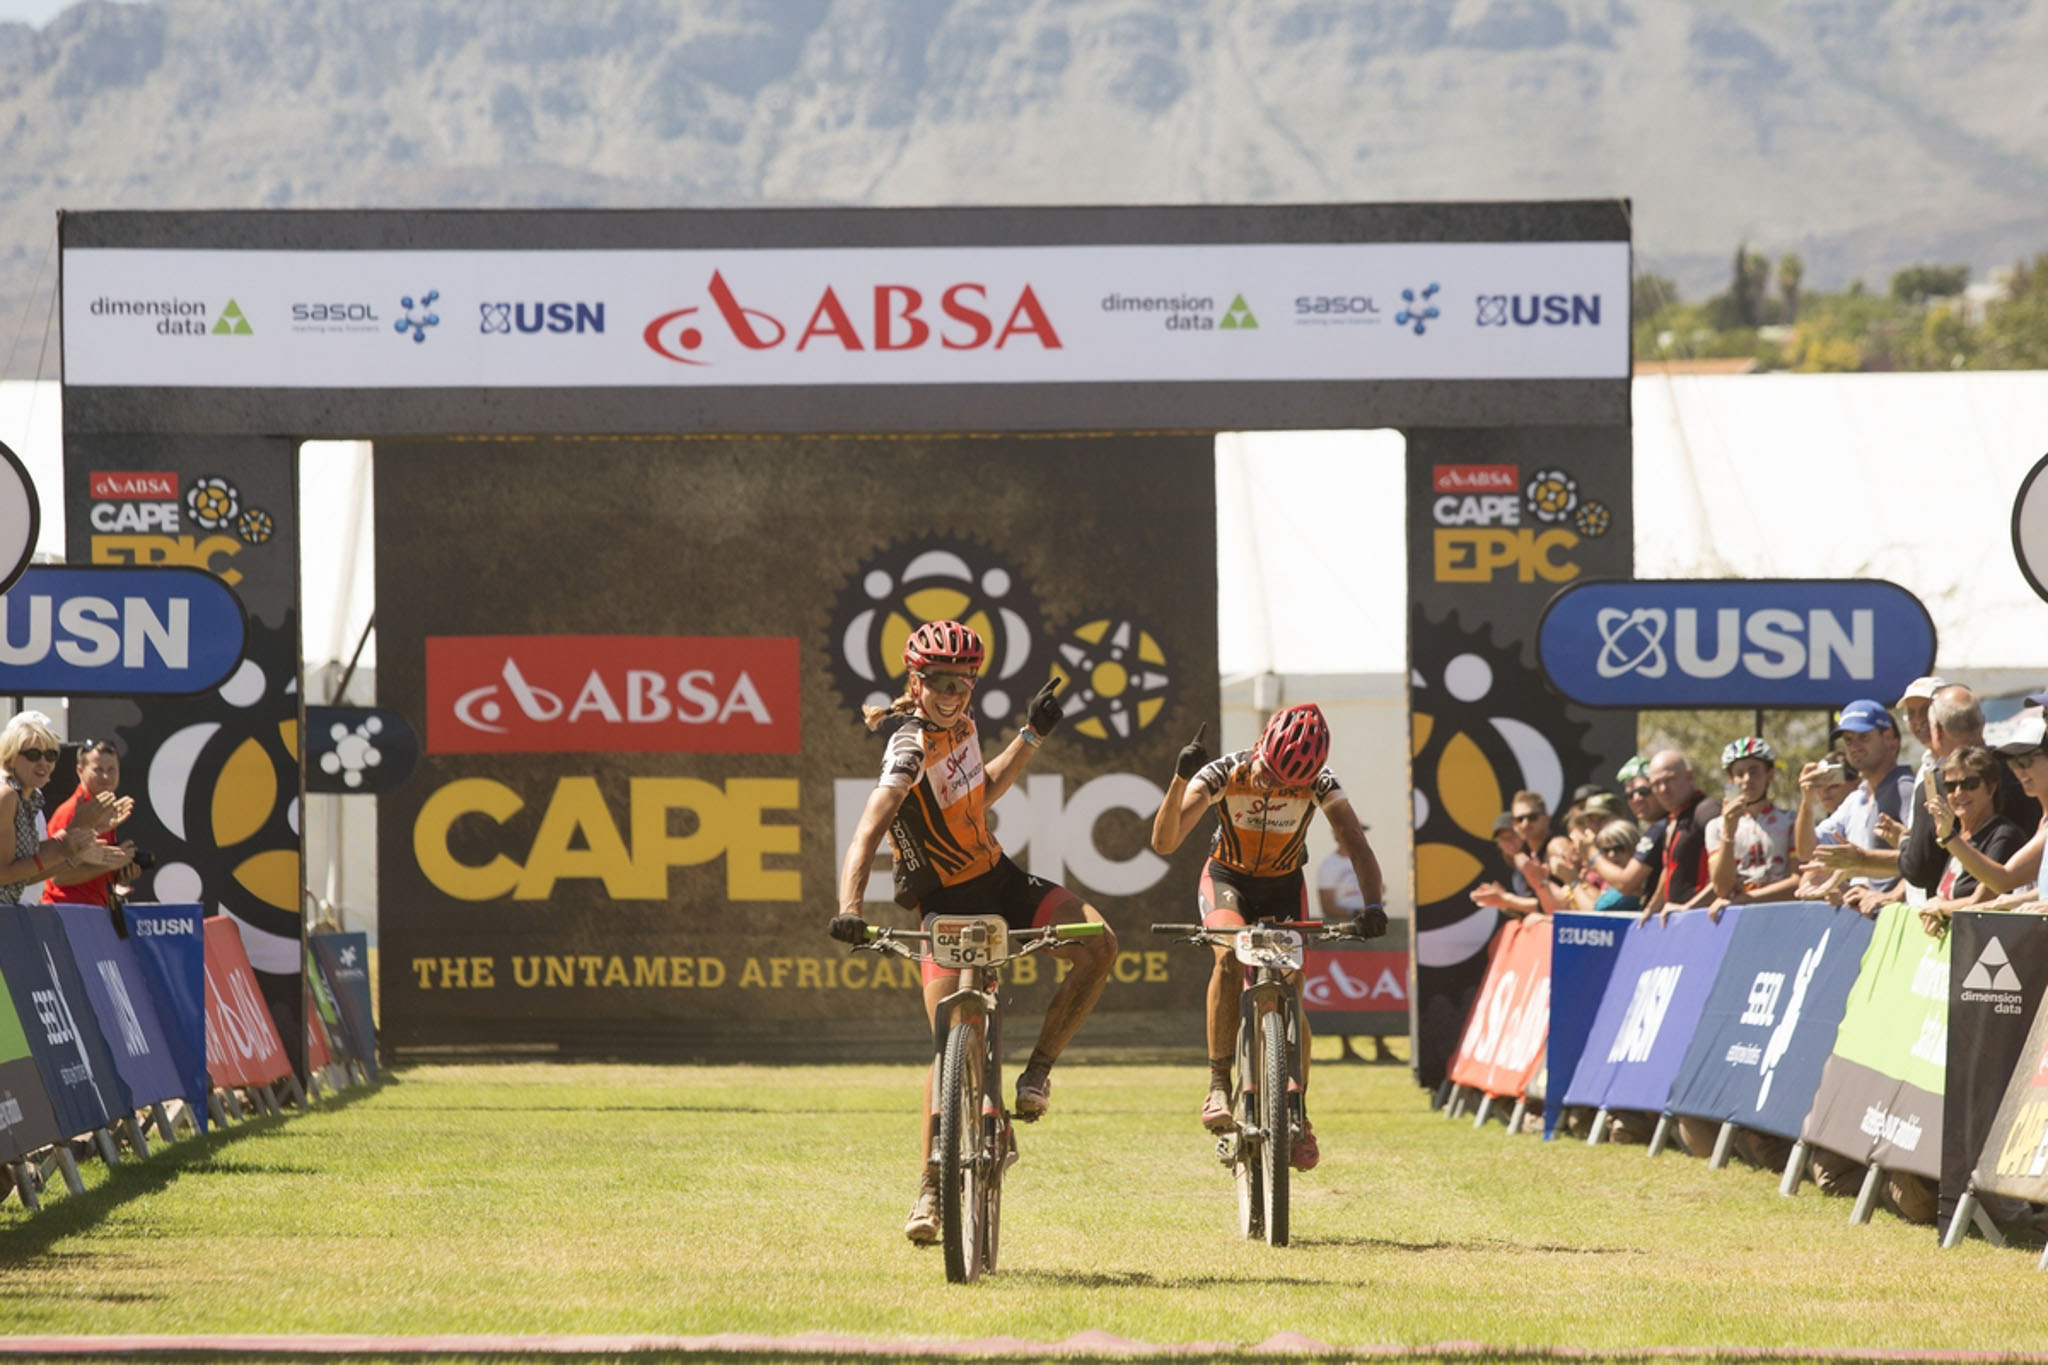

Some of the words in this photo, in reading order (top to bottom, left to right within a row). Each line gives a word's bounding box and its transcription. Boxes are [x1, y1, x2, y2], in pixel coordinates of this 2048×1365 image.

[90, 297, 206, 316] dimension
[795, 283, 1063, 351] ABSA
[1101, 293, 1213, 311] dimension
[1511, 294, 1601, 326] USN
[156, 317, 206, 335] data
[513, 301, 605, 334] USN
[1165, 312, 1213, 331] data
[124, 478, 172, 494] ABSA
[90, 502, 180, 532] CAPE
[1433, 495, 1521, 526] CAPE
[1433, 528, 1582, 584] EPIC
[0, 595, 190, 670] USN
[1674, 608, 1875, 681] USN
[567, 668, 773, 724] ABSA
[412, 776, 802, 901] CAPE
[152, 917, 194, 936] USN
[1574, 927, 1614, 947] USN
[412, 957, 496, 989] THE
[511, 955, 726, 988] UNTAMED
[739, 955, 922, 988] AFRICAN
[1056, 951, 1169, 984] RCE
[950, 947, 992, 963] 50-1
[1960, 990, 2022, 1004] dimension
[1993, 1002, 2022, 1015] data
